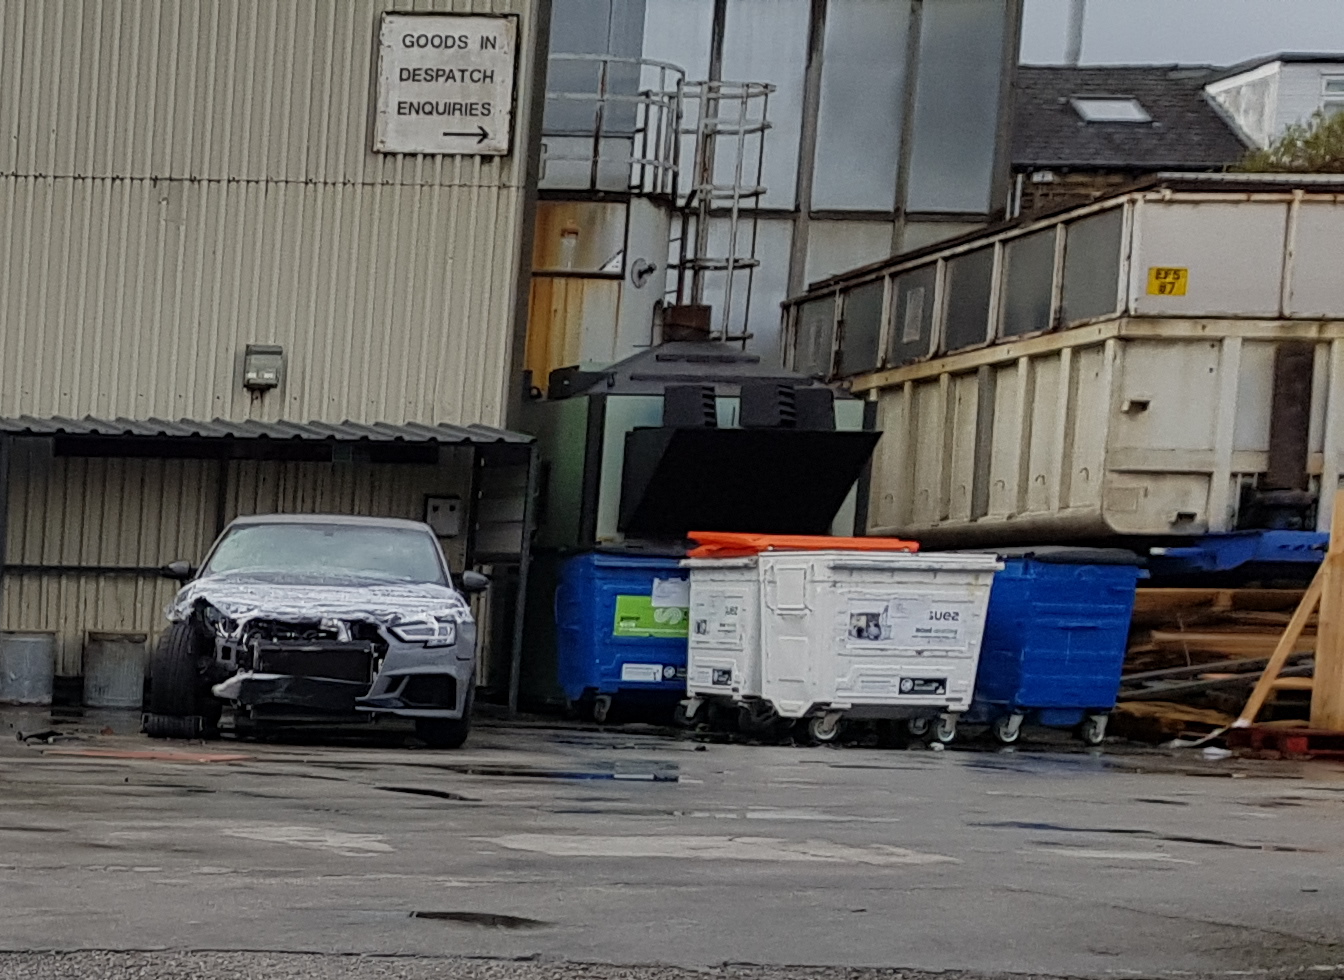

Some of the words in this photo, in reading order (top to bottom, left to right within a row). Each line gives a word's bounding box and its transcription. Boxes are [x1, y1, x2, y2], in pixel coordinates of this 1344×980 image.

[401, 33, 469, 50] GOODS
[480, 35, 497, 51] IN
[399, 67, 495, 84] DESPATCH
[397, 101, 492, 117] ENQUIRIES
